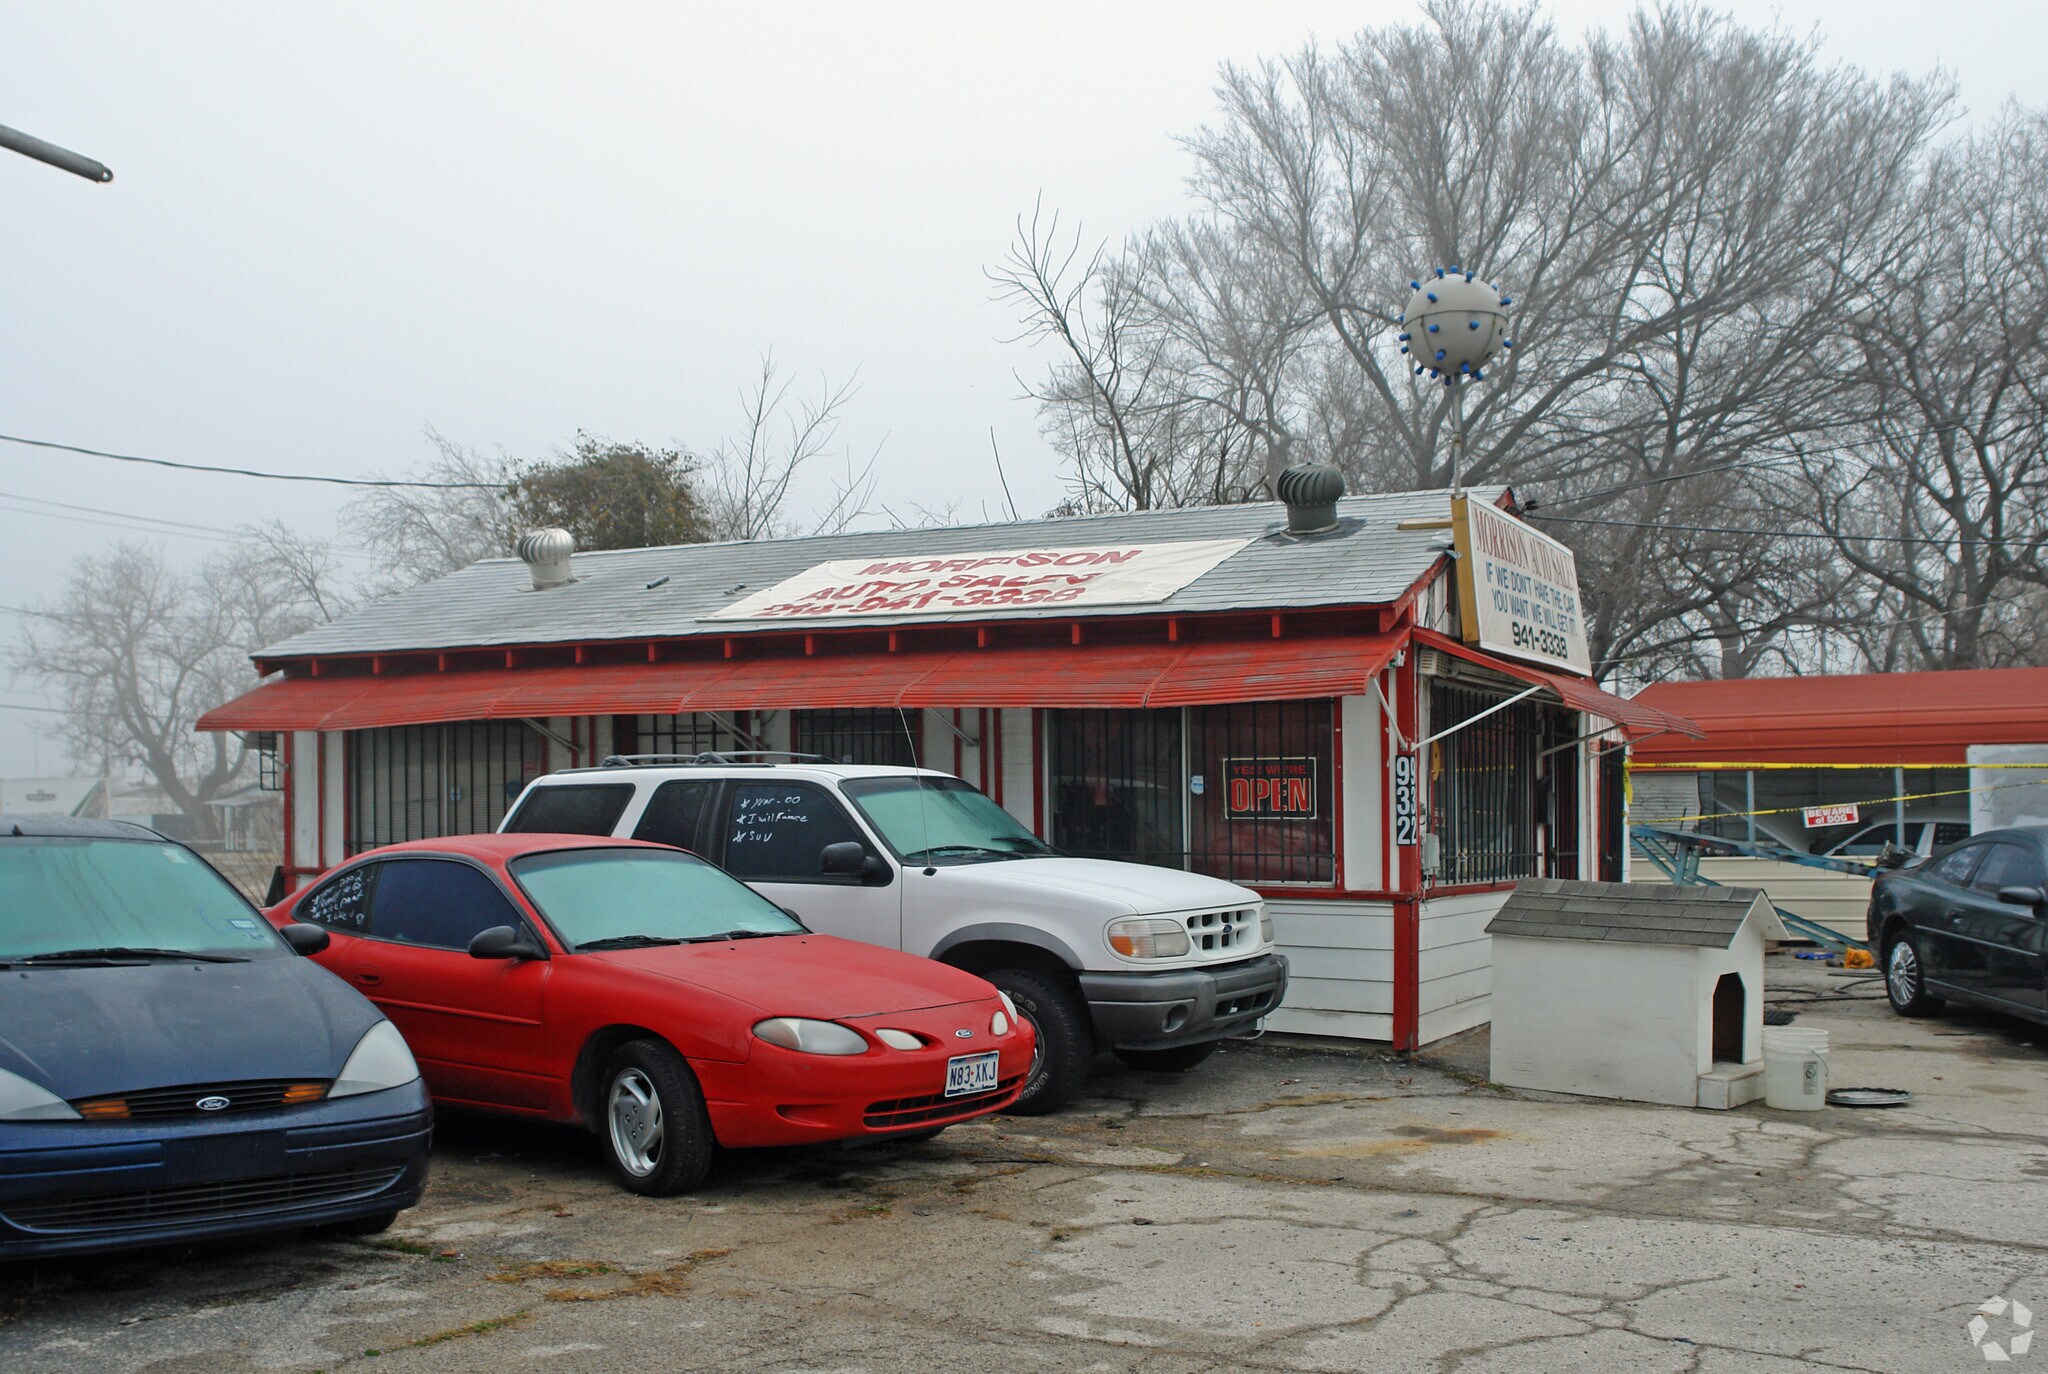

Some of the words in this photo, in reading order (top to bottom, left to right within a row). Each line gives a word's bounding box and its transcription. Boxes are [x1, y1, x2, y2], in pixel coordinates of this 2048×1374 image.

[1474, 507, 1529, 570] MORRISON
[796, 579, 931, 601] AUTO
[1486, 561, 1493, 583] IF
[1495, 565, 1509, 590] WE
[1511, 571, 1532, 596] DON'T
[1534, 579, 1550, 604] HAVE
[1550, 586, 1563, 611] THE
[1492, 588, 1509, 614] YOU
[1509, 594, 1529, 620] WANT
[1530, 602, 1543, 624] WE
[1543, 606, 1558, 630] WILL
[1557, 612, 1569, 634] GET
[1512, 621, 1568, 660] 941-3338
[1231, 777, 1312, 812] OPEN
[1808, 805, 1853, 817] BEWARE
[747, 813, 757, 825] I
[1815, 816, 1825, 826] of
[1827, 813, 1847, 823] DOG
